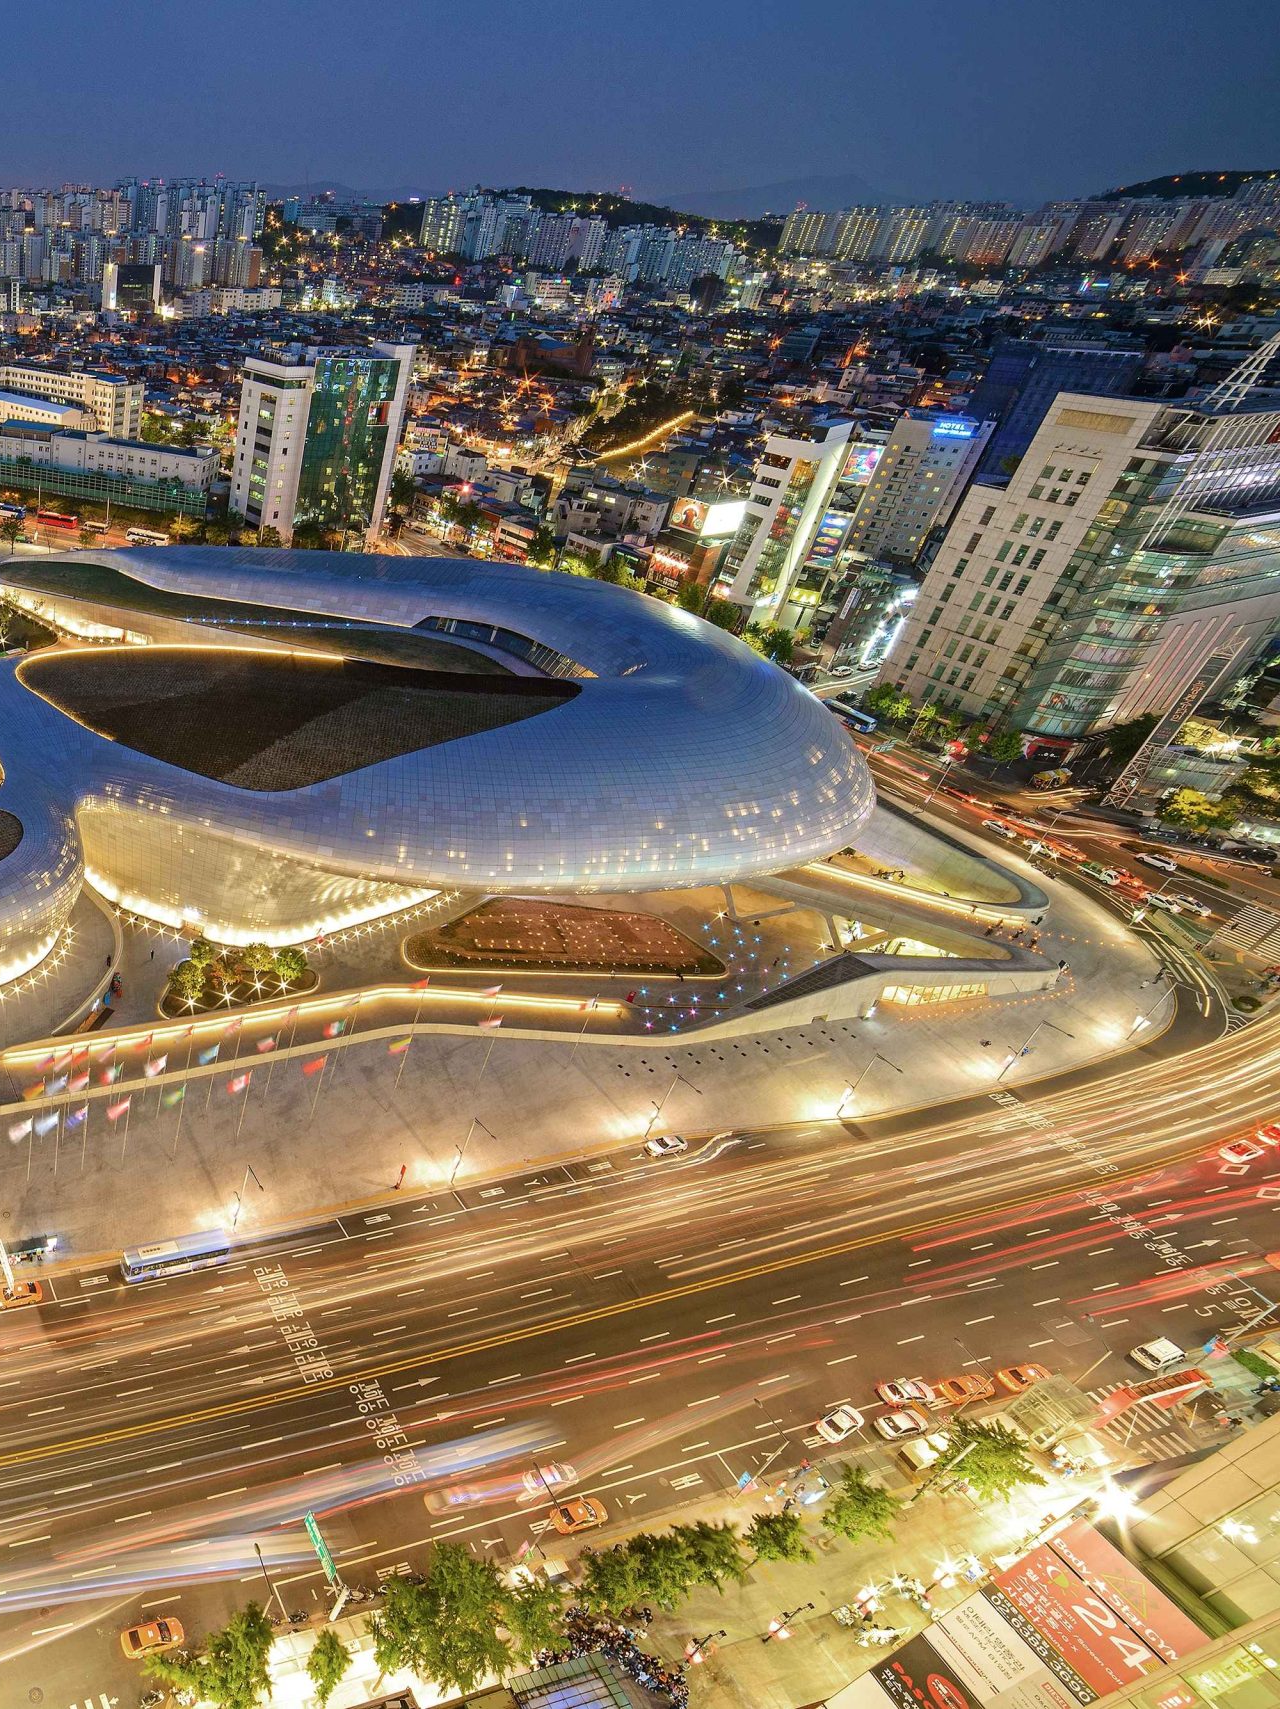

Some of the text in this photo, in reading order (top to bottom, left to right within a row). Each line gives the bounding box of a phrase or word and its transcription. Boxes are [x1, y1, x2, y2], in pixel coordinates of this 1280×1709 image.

[939, 422, 965, 430] HOTEL
[253, 1263, 289, 1292] 동대문
[280, 1321, 318, 1352] 동대문
[294, 1351, 334, 1384] 동대문
[349, 1379, 390, 1413] 광희동
[365, 1413, 408, 1449] 광희동
[383, 1448, 427, 1486] 광희동
[1052, 1537, 1093, 1575] Body
[1108, 1593, 1146, 1628] Star
[991, 1595, 1091, 1702] 02.6388.3690
[1071, 1597, 1153, 1676] 24
[881, 1674, 899, 1700] TEL.
